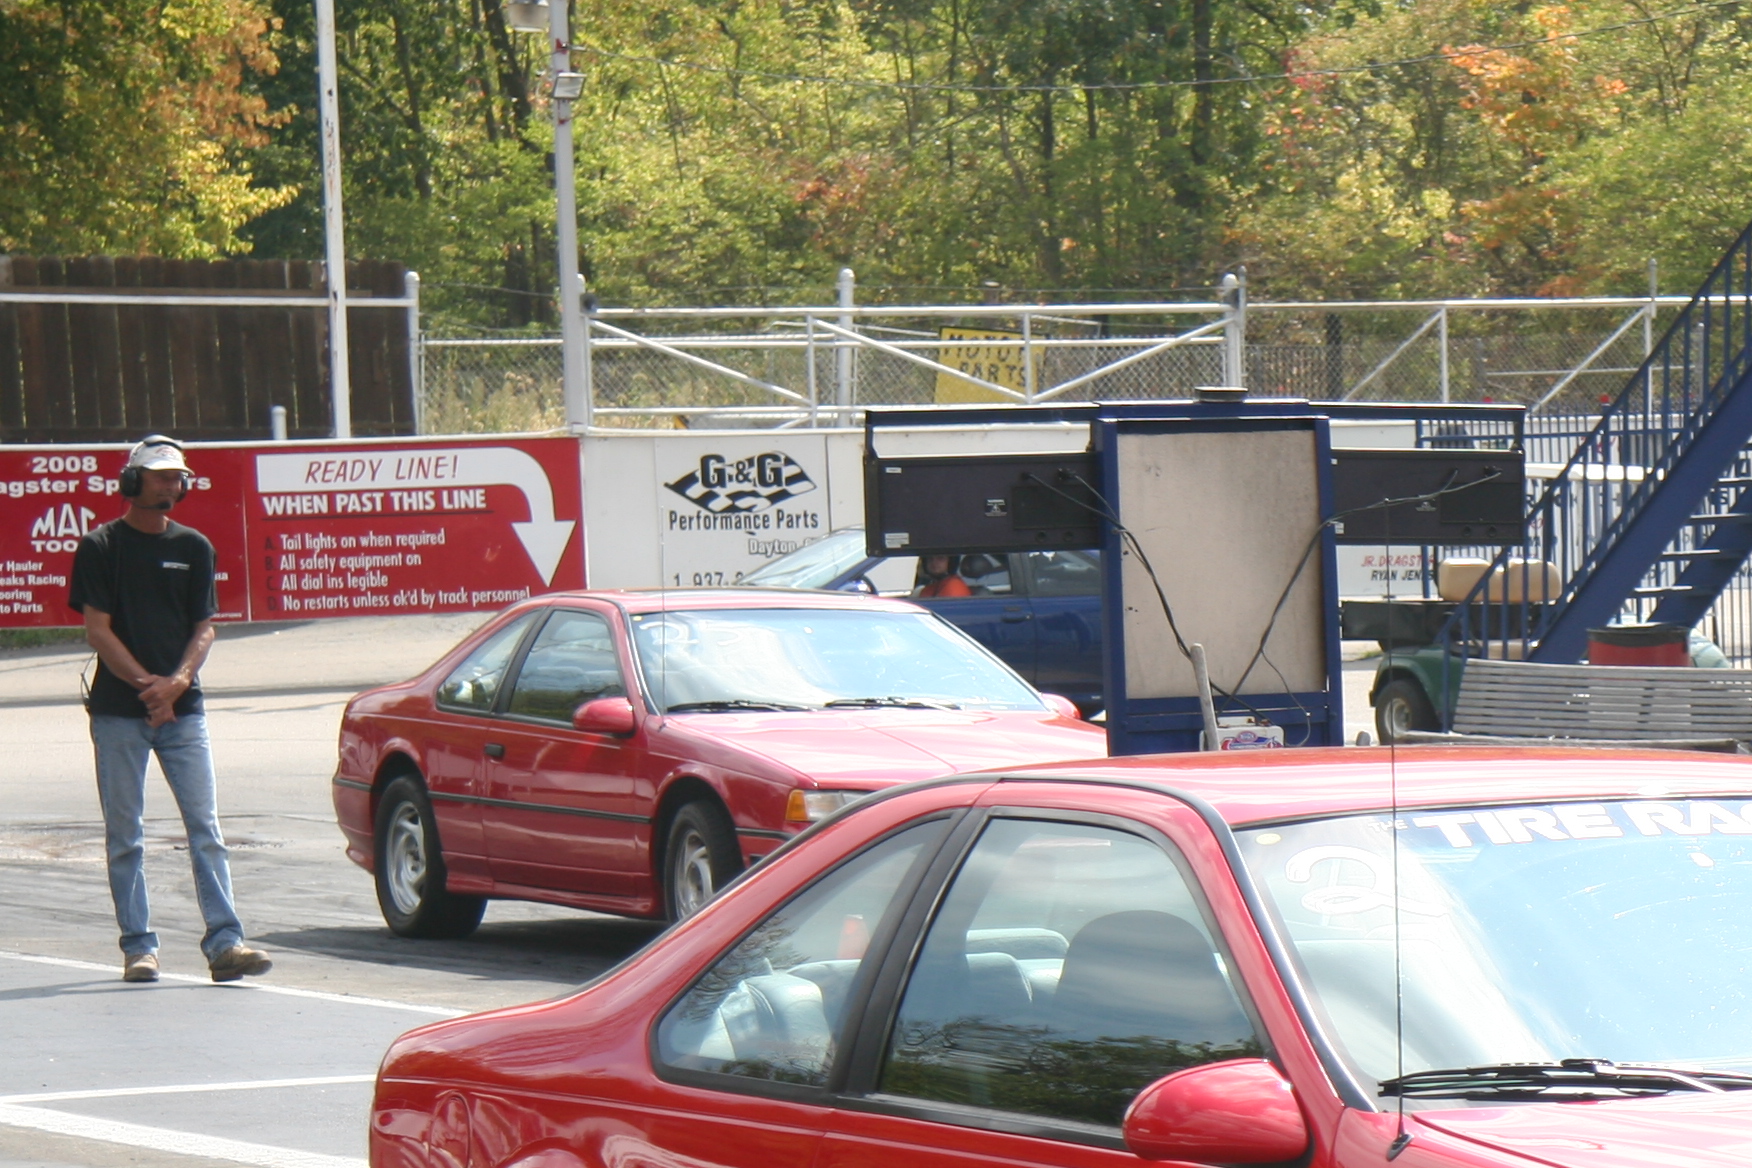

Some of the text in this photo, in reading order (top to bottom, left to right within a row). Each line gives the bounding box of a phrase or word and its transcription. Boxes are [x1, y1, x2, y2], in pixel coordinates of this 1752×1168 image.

[32, 456, 98, 473] 2008
[305, 455, 459, 484] READY LINE!
[701, 453, 784, 488] G&G
[262, 489, 486, 516] WHEN PAST THIS LINE
[669, 509, 819, 531] Performance Parts
[281, 534, 301, 550] Tail
[305, 532, 337, 552] lights
[341, 536, 356, 548] on
[360, 531, 392, 547] when
[396, 528, 445, 547] required
[6, 560, 43, 572] Hauler
[280, 554, 295, 570] All
[300, 554, 335, 573] safety
[340, 553, 402, 573] equipment
[406, 554, 421, 566] on
[27, 574, 67, 587] Racing
[281, 574, 297, 590] All
[302, 572, 323, 589] dial
[327, 572, 344, 588] ins
[348, 570, 388, 591] legible
[13, 603, 43, 613] Parts
[283, 596, 300, 611] No
[304, 594, 350, 611] restarts
[353, 592, 389, 608] unless
[393, 588, 418, 606] ok'd
[422, 589, 435, 608] by
[439, 587, 468, 604] track
[472, 586, 530, 608] personnel
[1415, 805, 1624, 848] TIRE
